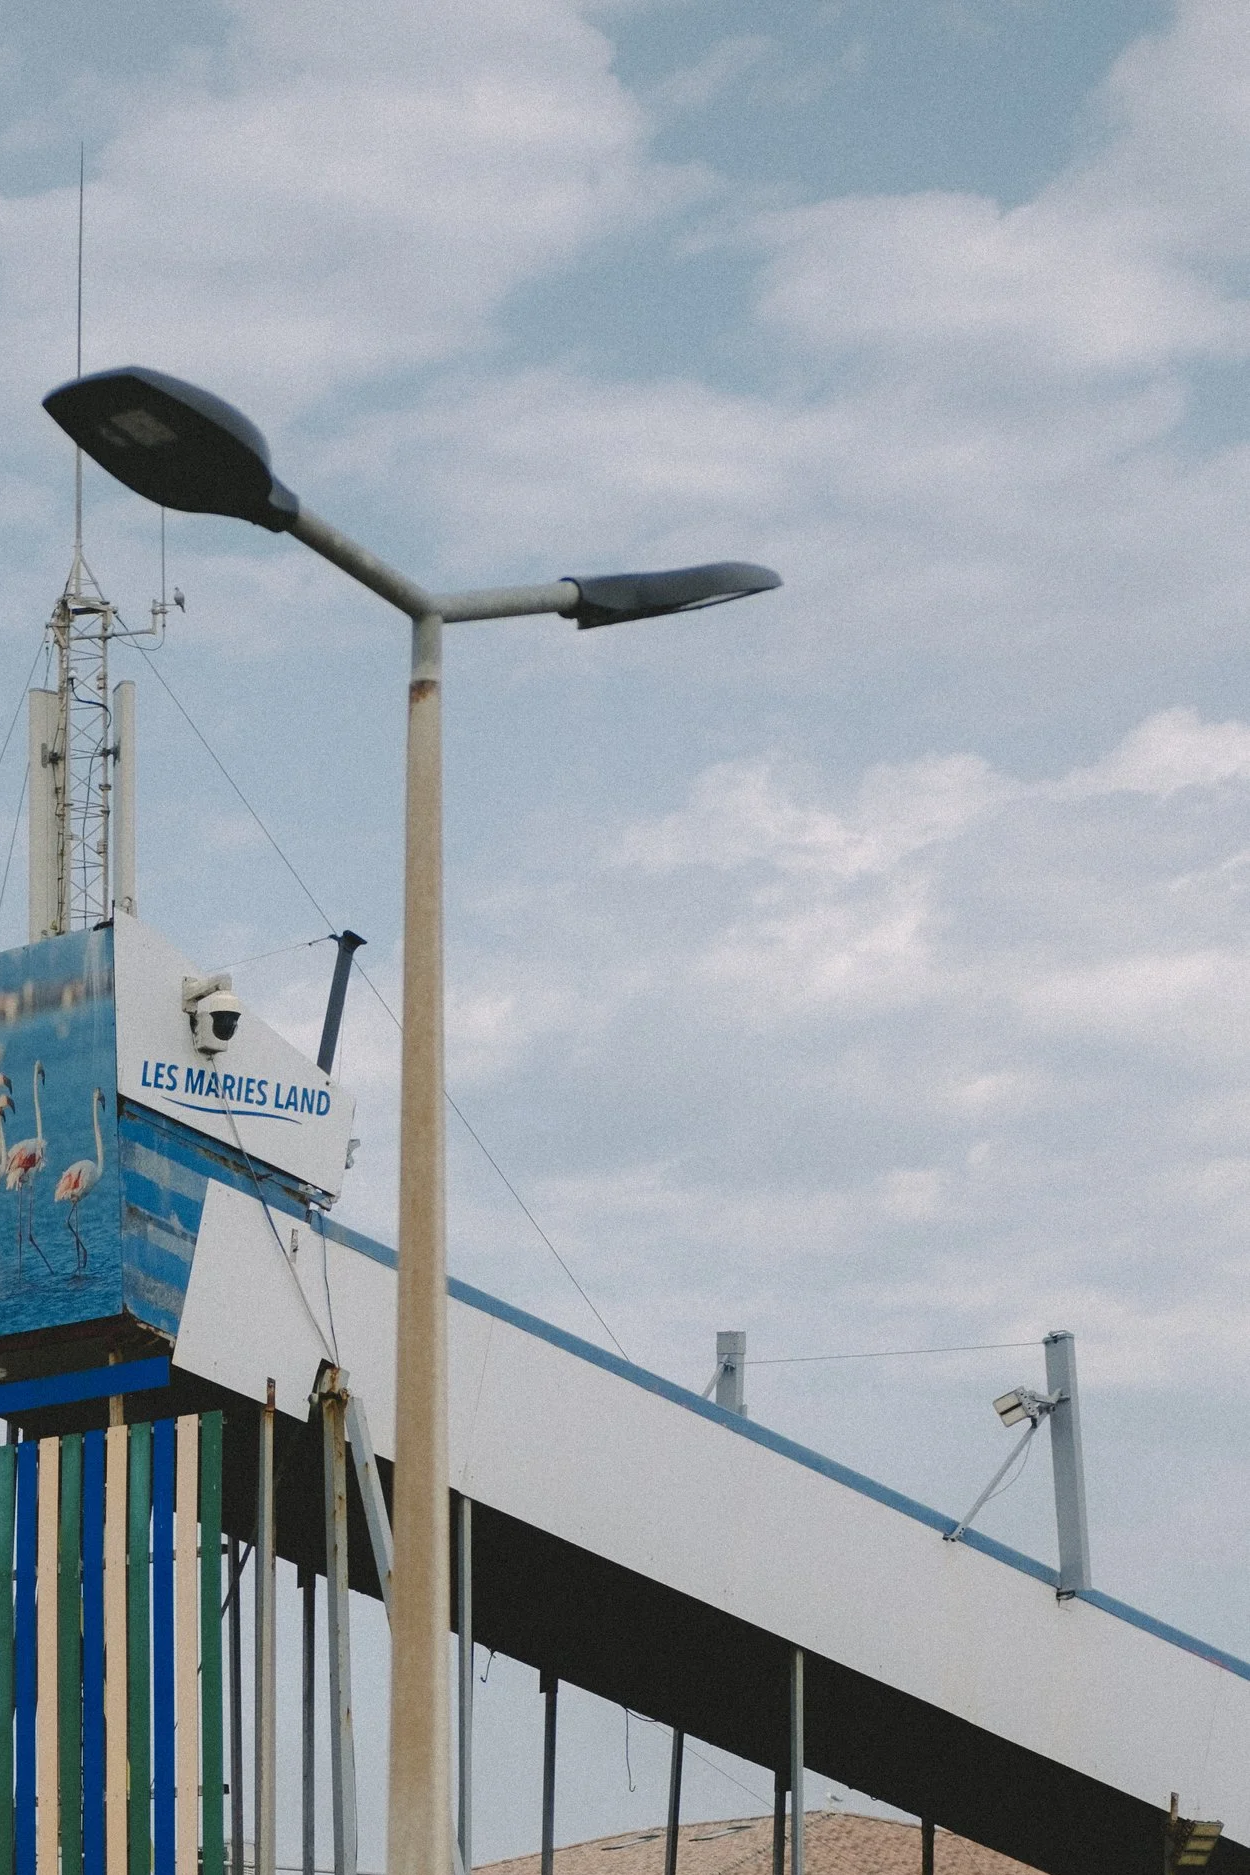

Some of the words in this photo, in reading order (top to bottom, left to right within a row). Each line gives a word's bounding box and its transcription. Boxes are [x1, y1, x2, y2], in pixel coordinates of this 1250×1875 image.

[141, 1060, 179, 1091] LES
[184, 1067, 268, 1106] MARIES
[274, 1083, 331, 1116] LAND
